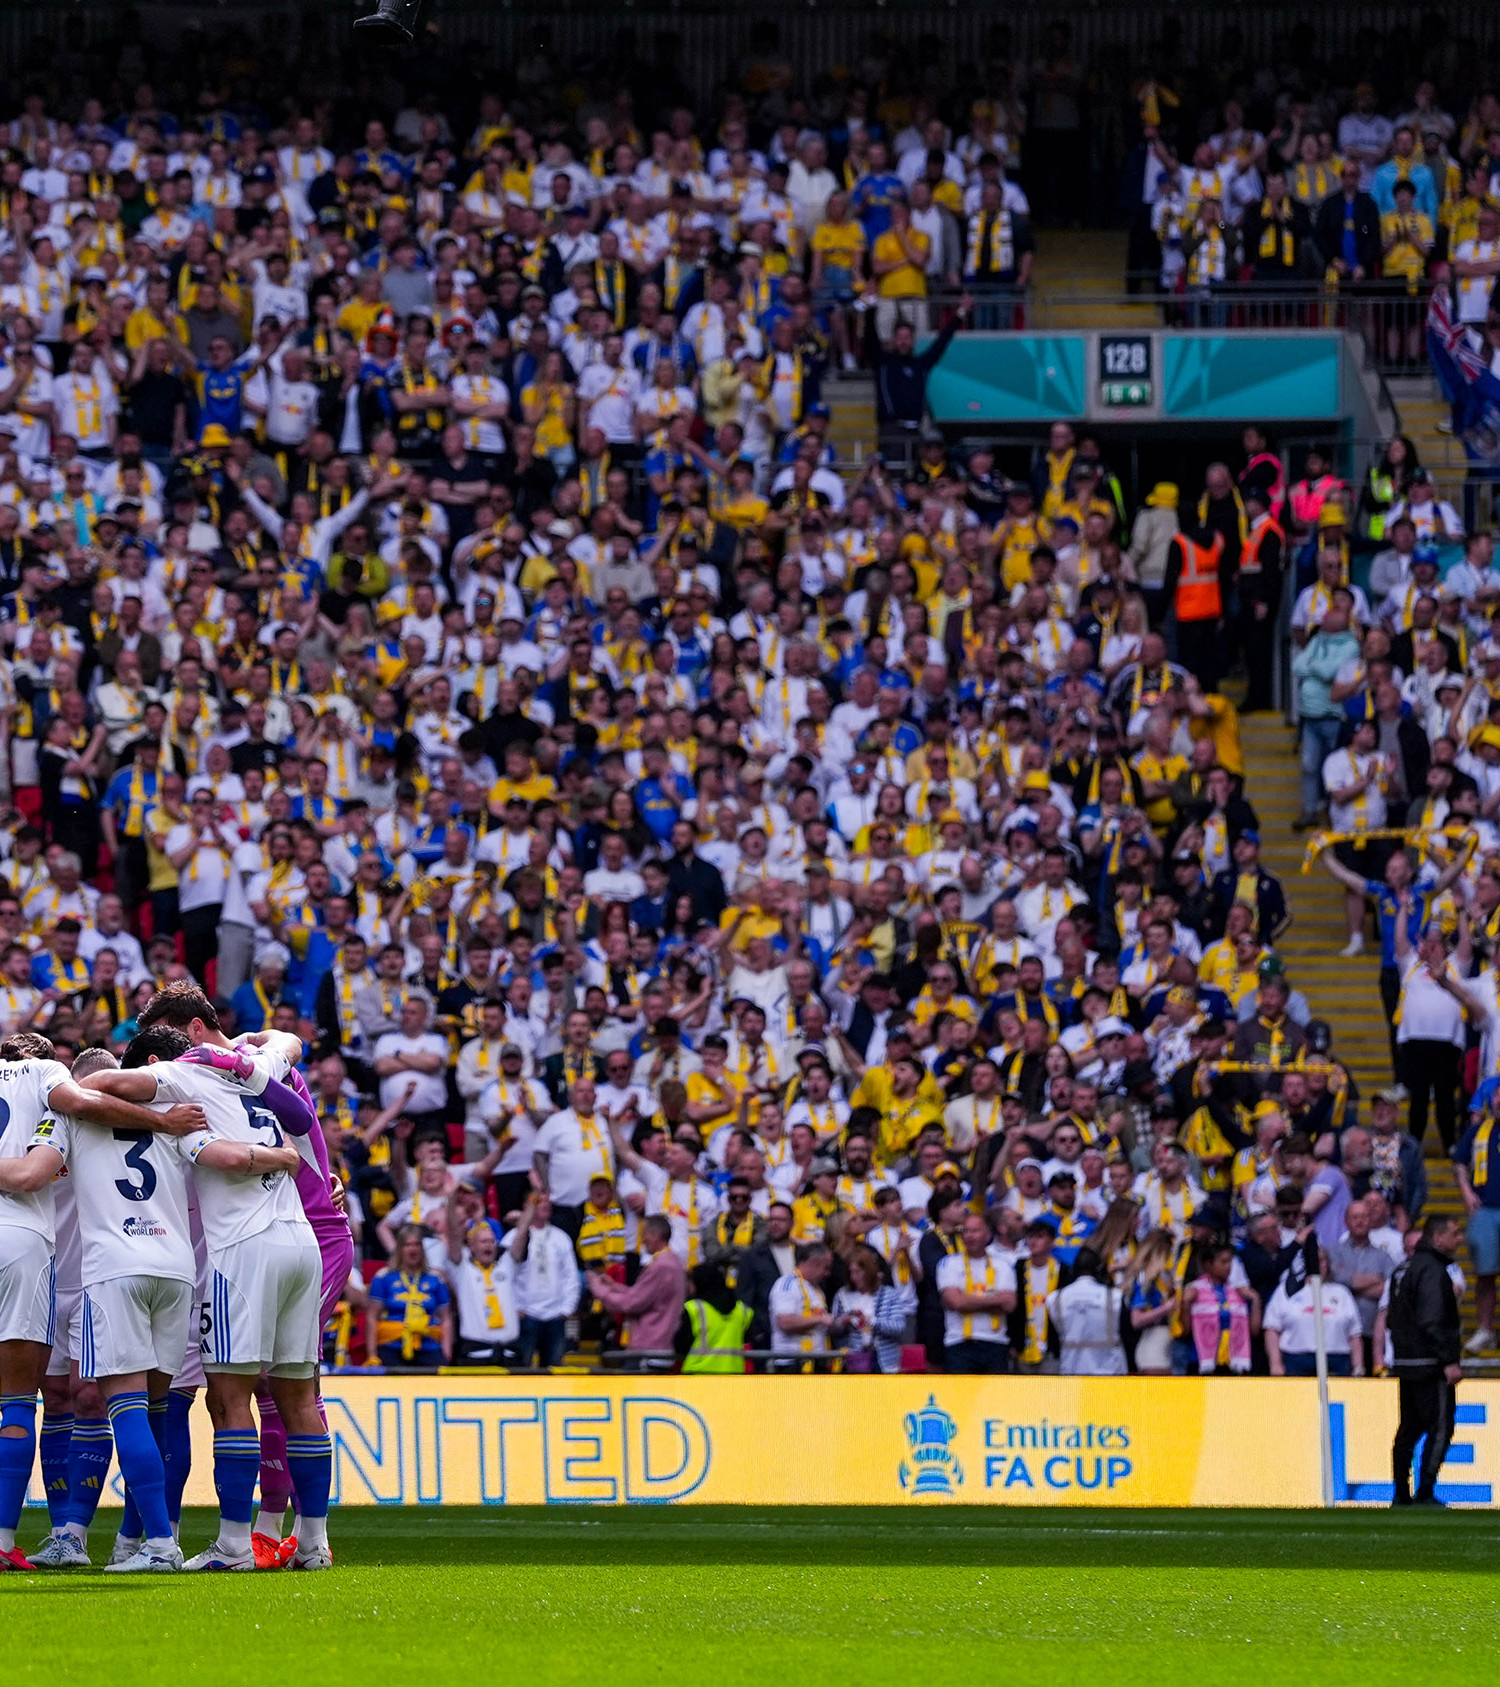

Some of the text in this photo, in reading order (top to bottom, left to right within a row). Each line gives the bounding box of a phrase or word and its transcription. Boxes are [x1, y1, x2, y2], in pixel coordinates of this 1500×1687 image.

[1103, 342, 1147, 373] 128
[239, 1095, 286, 1149] 5
[112, 1128, 157, 1202] 3
[200, 1302, 212, 1335] 5
[984, 1417, 1131, 1448] Emirates
[322, 1397, 712, 1505] NITED
[985, 1456, 1133, 1489] FA CUP
